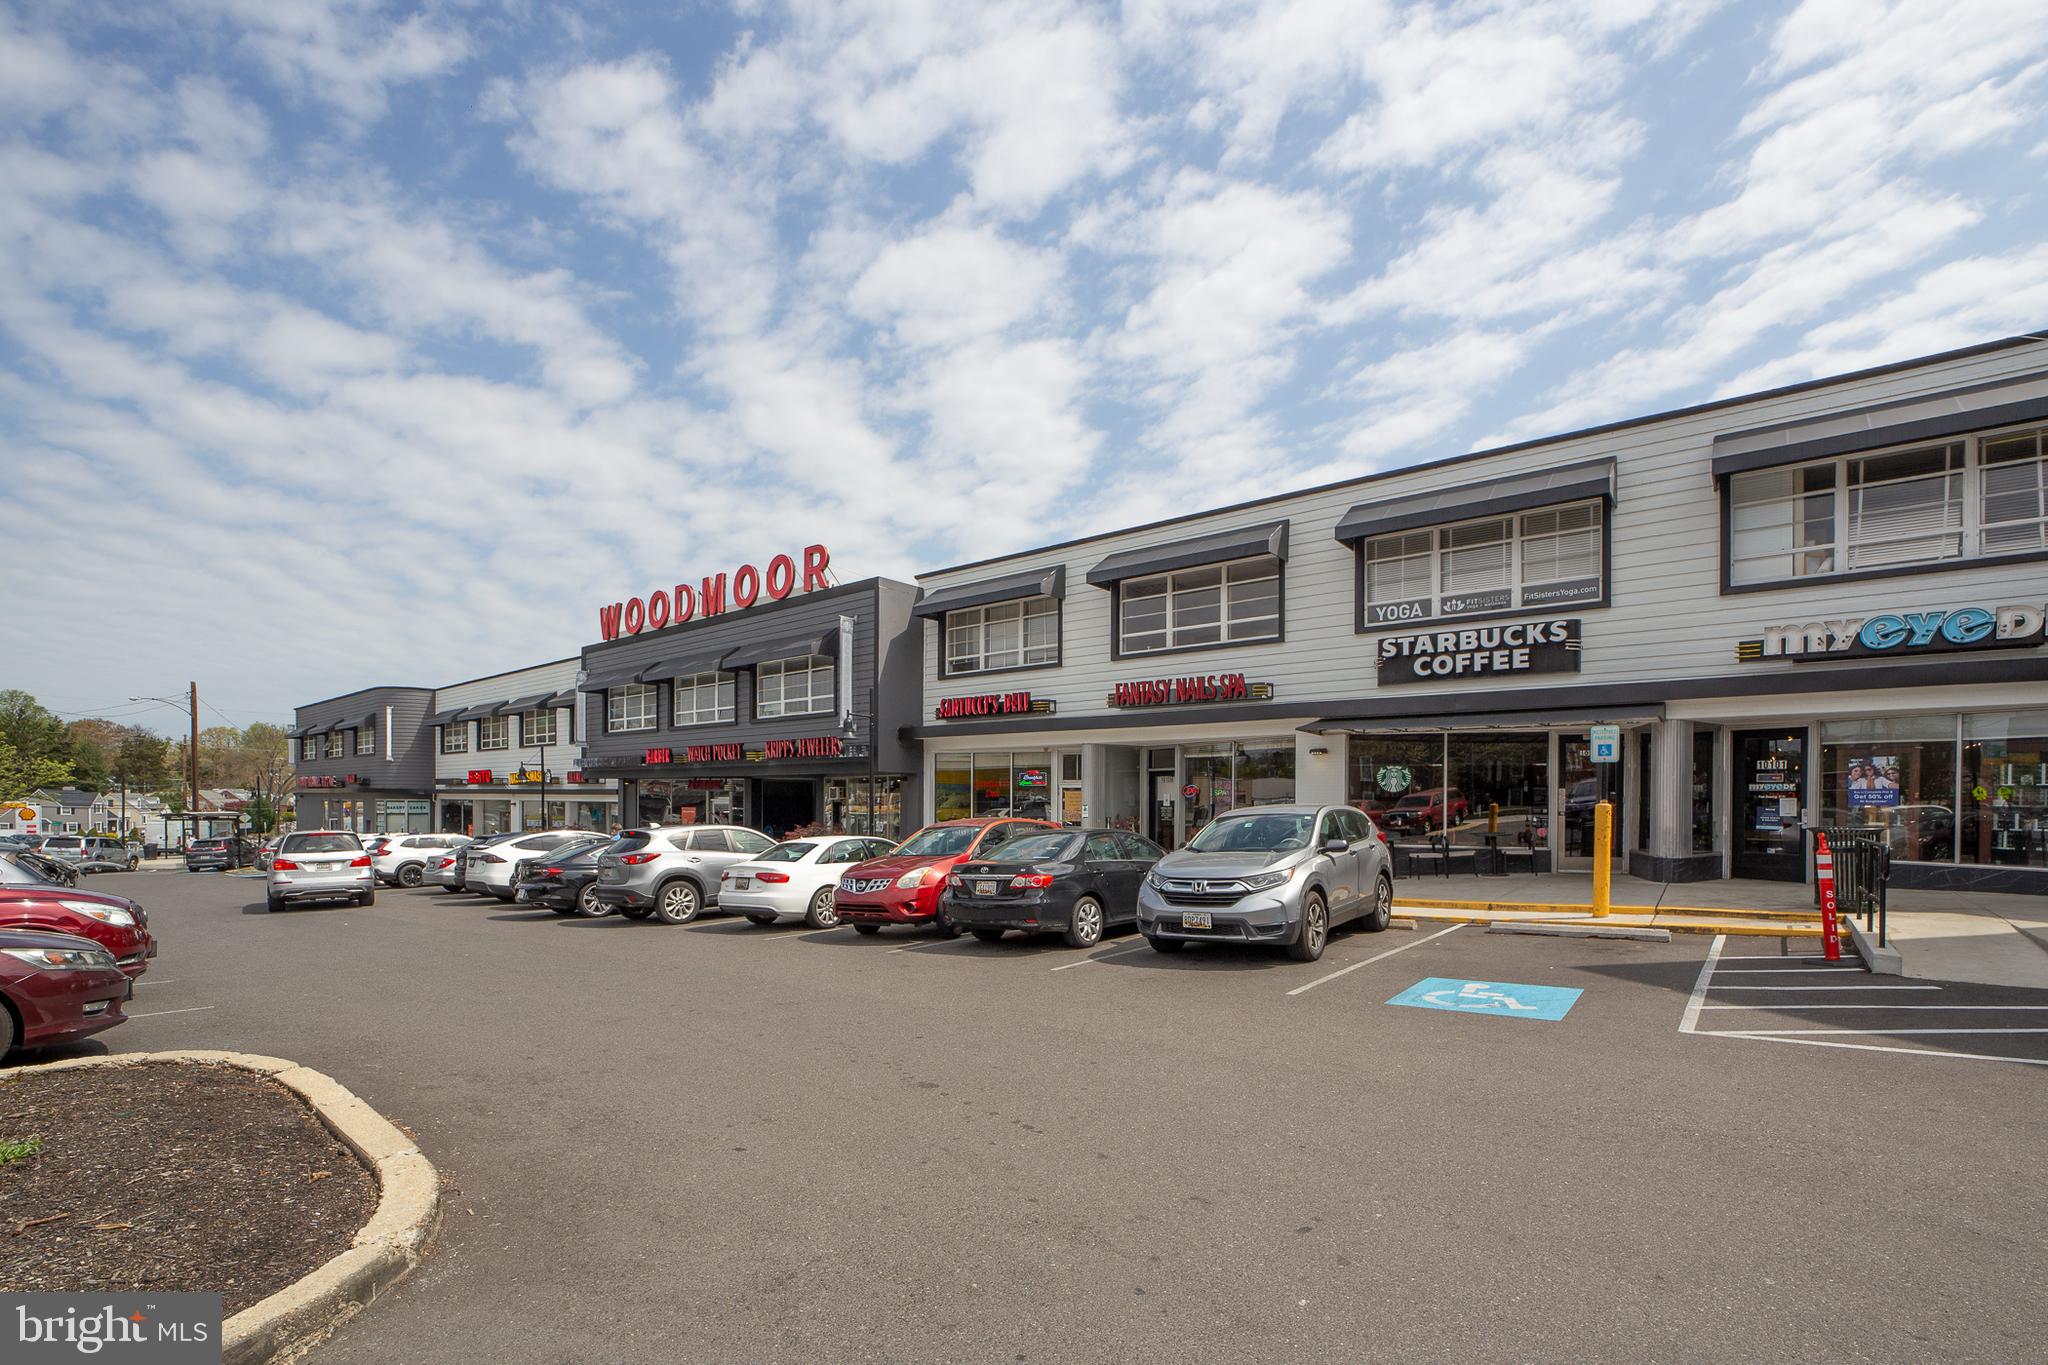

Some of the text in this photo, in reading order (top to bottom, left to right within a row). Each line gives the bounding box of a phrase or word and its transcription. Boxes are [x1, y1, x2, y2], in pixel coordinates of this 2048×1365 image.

[600, 544, 830, 641] WOODMOOR
[1466, 594, 1510, 606] FITSISTERS
[1523, 585, 1597, 601] FitSistersYoga.com
[1376, 603, 1423, 621] YOGA
[1381, 620, 1568, 659] STARBUCKS
[1413, 647, 1531, 677] COFFEE
[1114, 673, 1247, 705] FANTASY NAILS SPA
[940, 692, 1031, 717] SANTUCCI'S DELI
[646, 748, 672, 764] BARBER
[687, 743, 744, 762] WATCH POCKET
[797, 736, 843, 758] JEWELERS
[1826, 890, 1838, 943] SOLID
